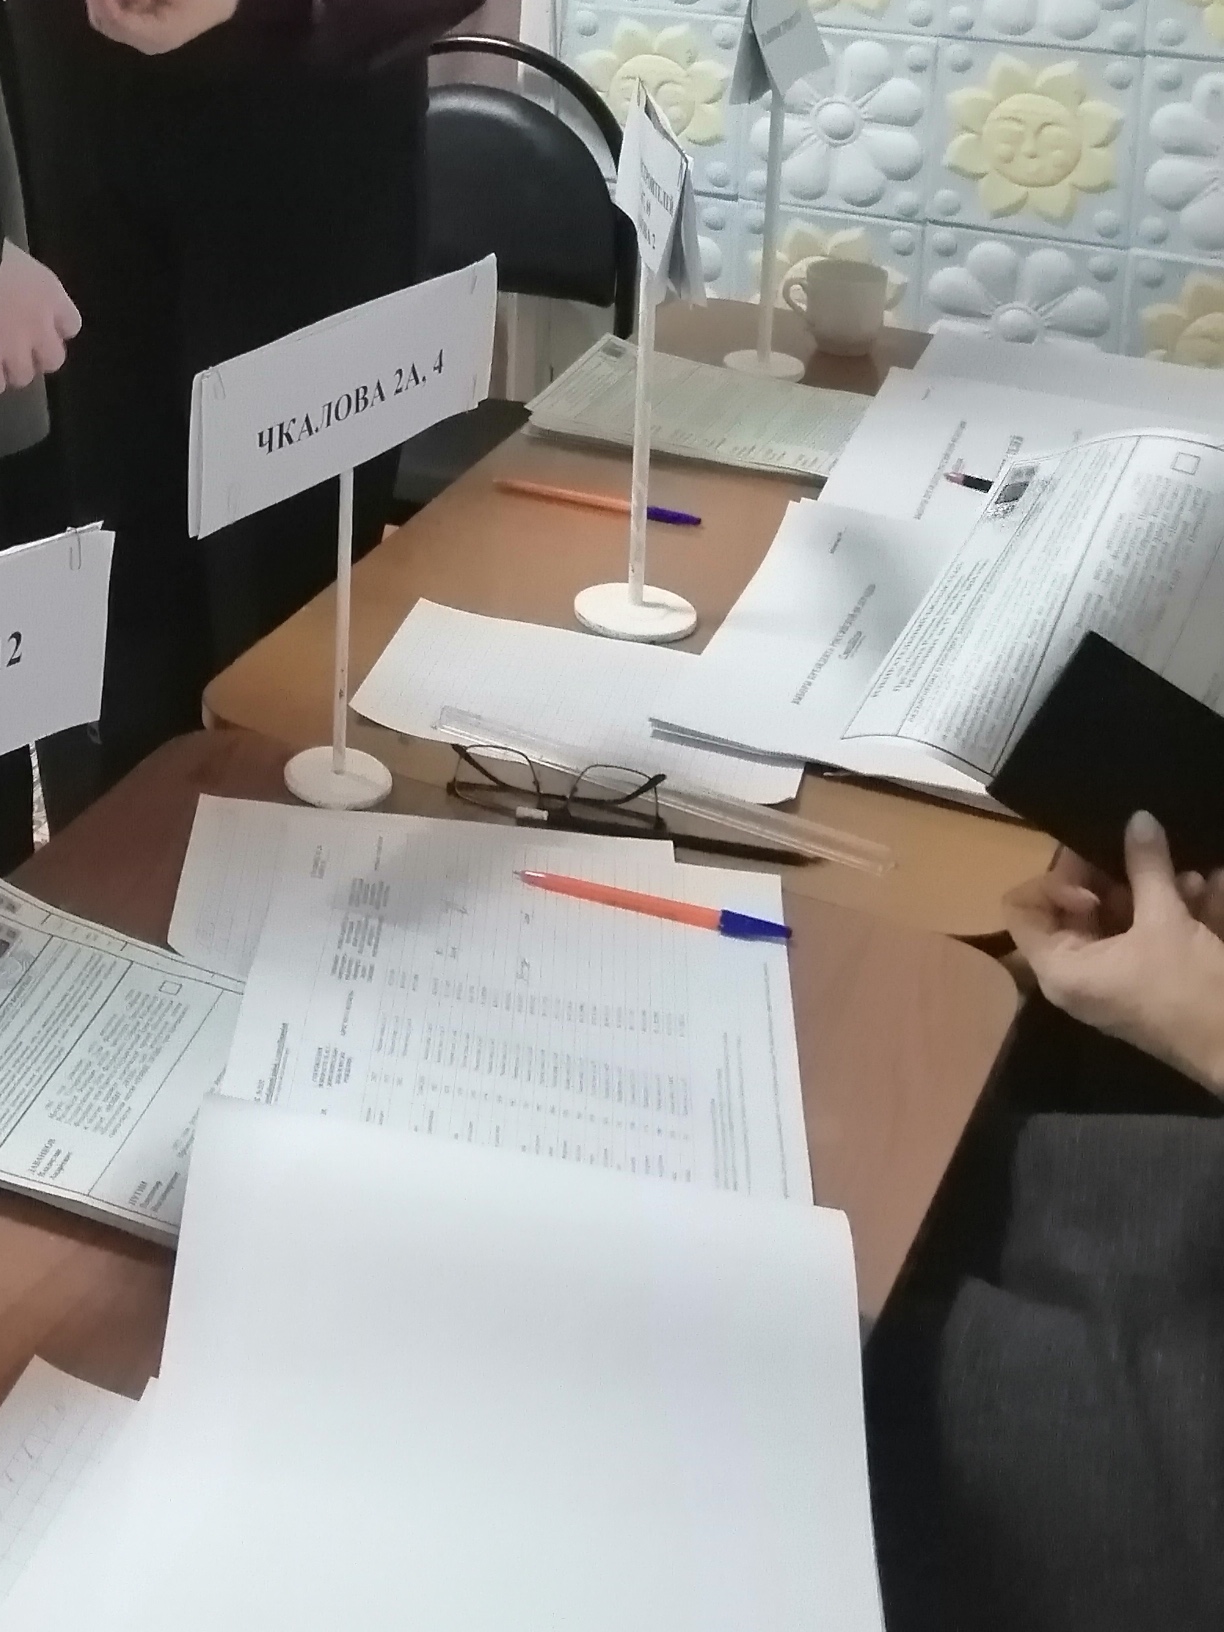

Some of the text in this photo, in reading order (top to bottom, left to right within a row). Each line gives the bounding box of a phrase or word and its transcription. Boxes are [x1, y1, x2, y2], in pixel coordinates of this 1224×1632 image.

[257, 348, 445, 455] ЧКАЛОВА 2А, 4
